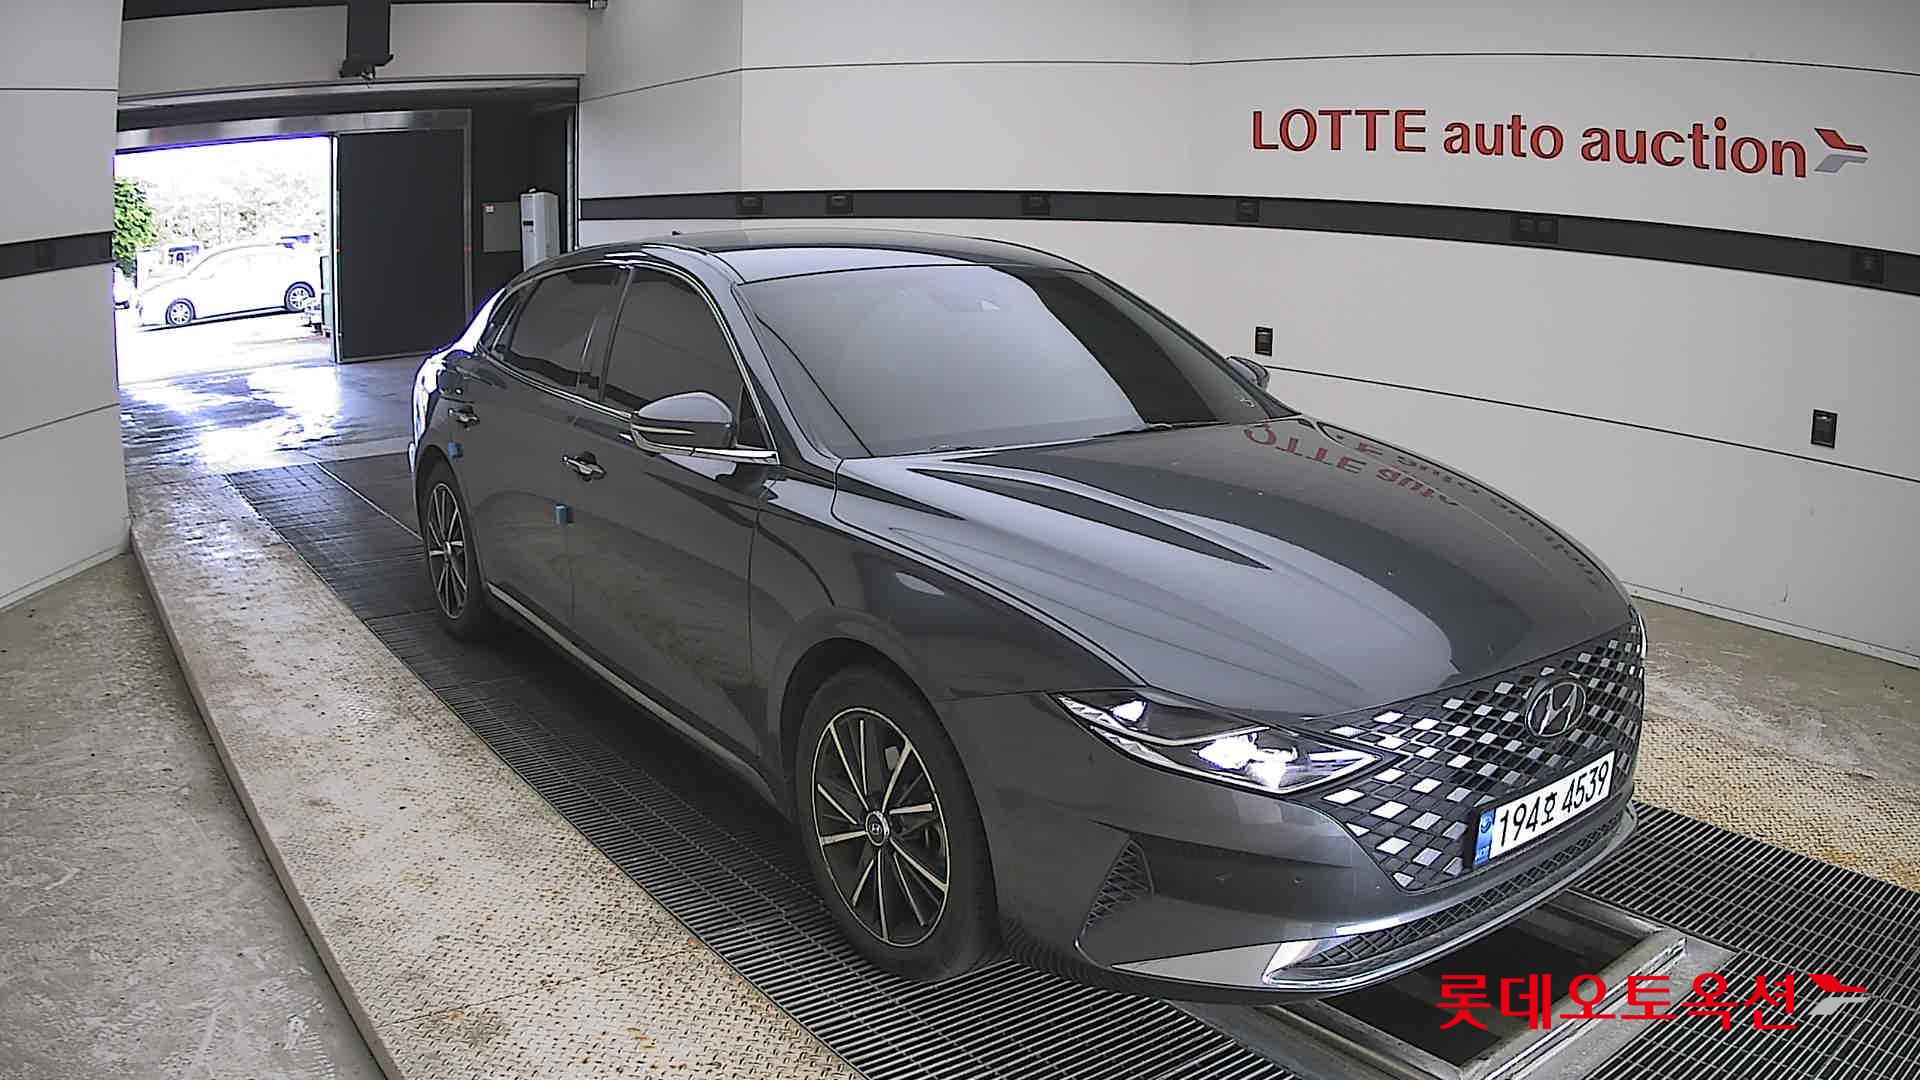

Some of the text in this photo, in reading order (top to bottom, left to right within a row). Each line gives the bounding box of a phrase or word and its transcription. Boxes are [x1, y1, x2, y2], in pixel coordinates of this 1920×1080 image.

[1252, 109, 1809, 178] LOTTE auto auction
[1500, 760, 1609, 847] 194호 4539
